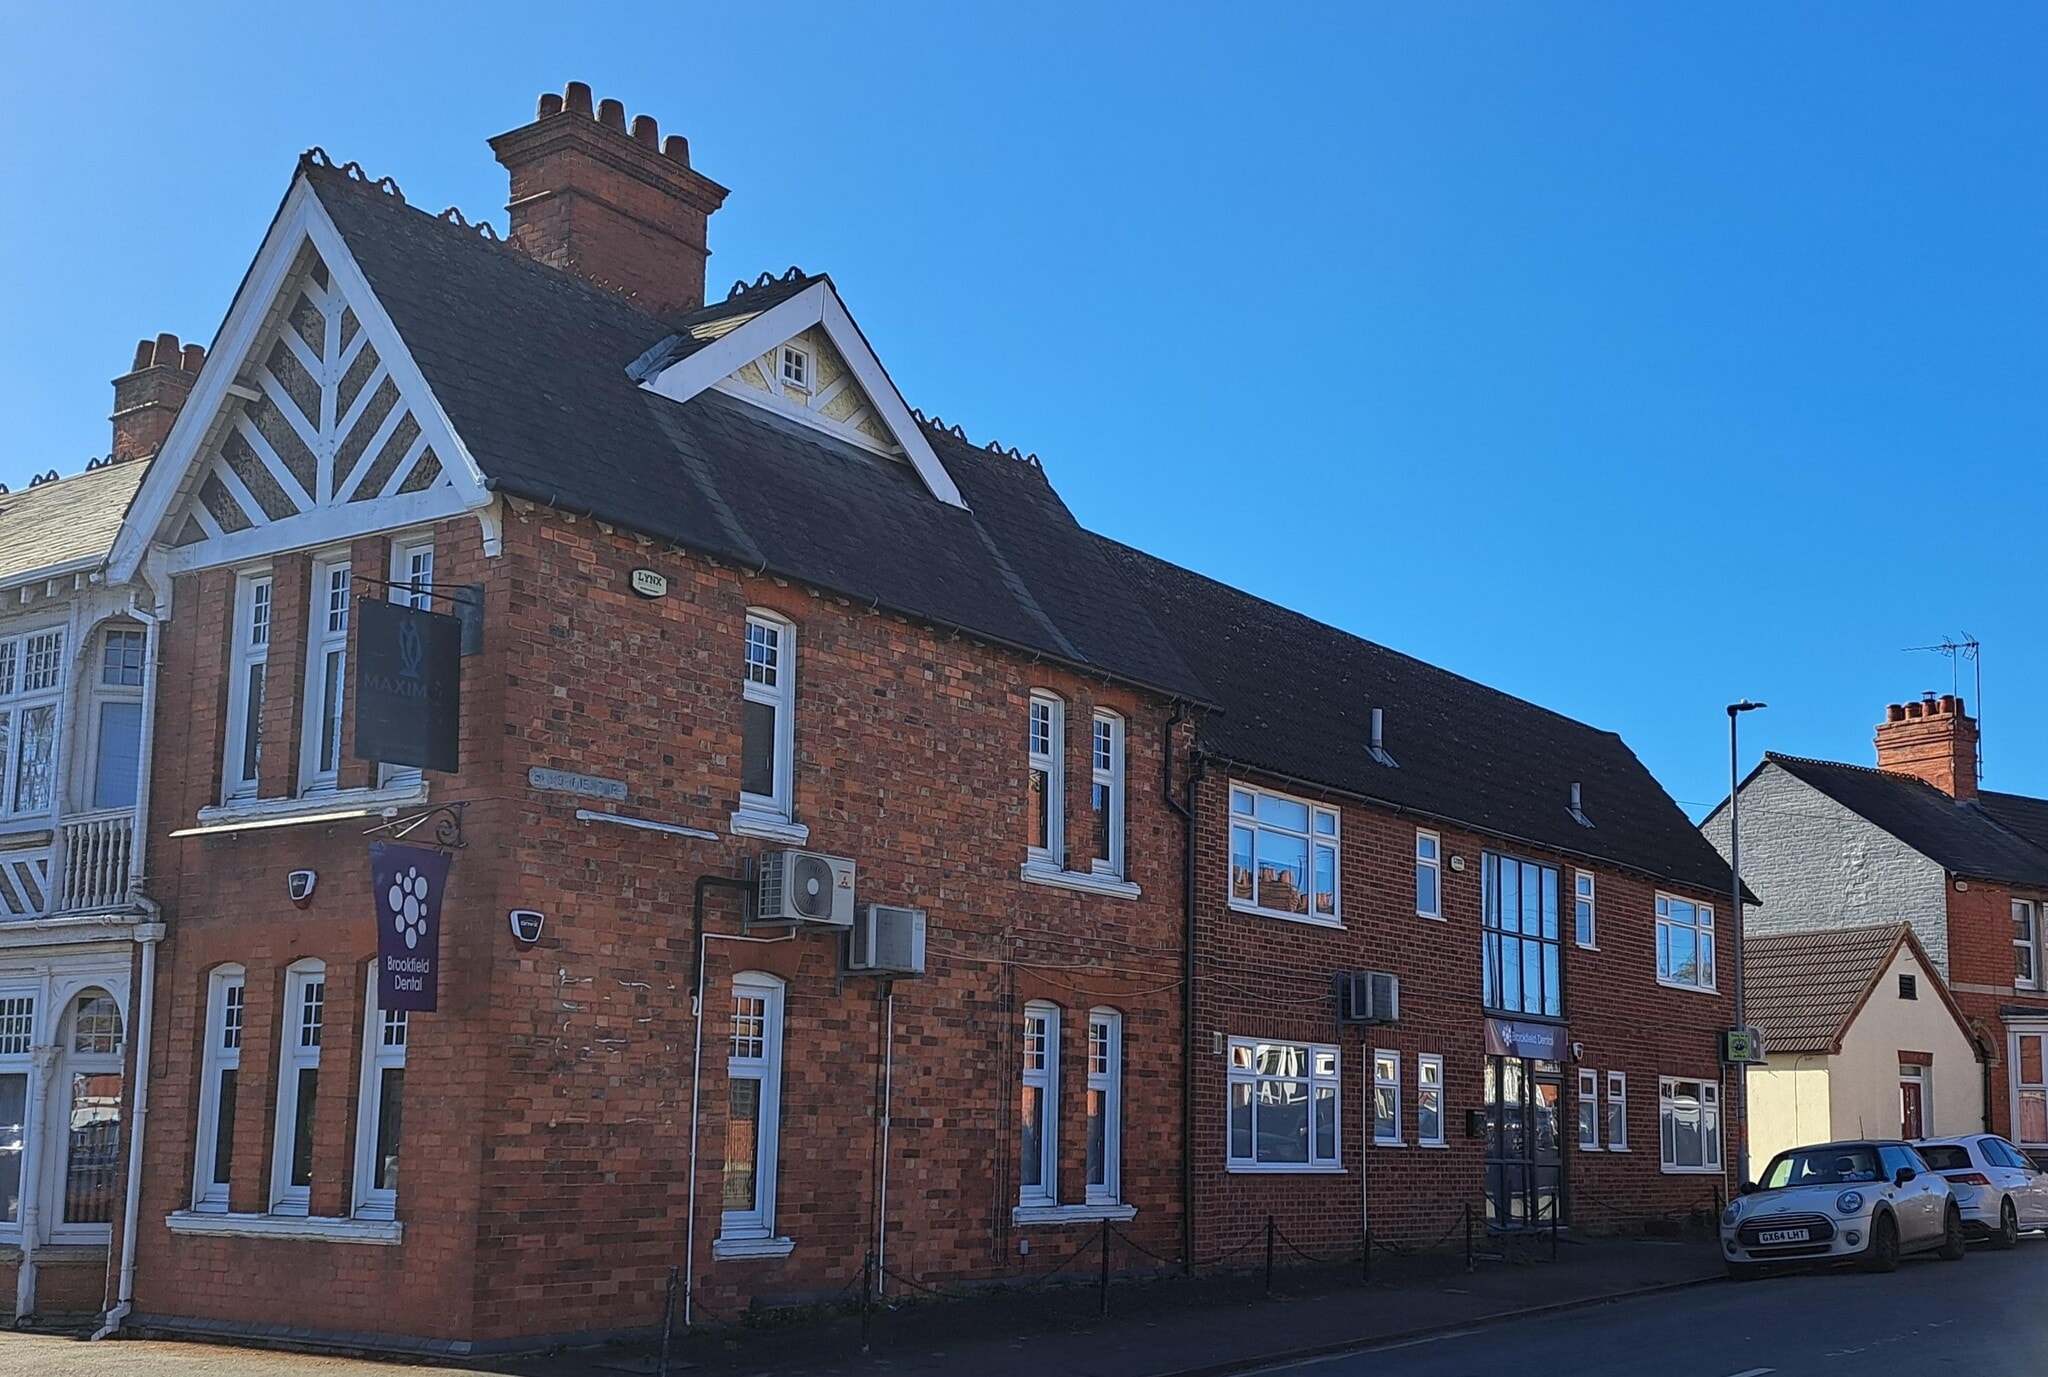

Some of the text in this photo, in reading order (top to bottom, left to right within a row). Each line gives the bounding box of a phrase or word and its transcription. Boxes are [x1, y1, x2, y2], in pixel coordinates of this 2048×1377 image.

[638, 572, 662, 586] LYNX
[387, 955, 430, 973] Brookfield
[394, 975, 423, 991] Dental
[1512, 1031, 1554, 1046] Brookfield Dental
[1762, 1230, 1804, 1242] GX64 LHT
